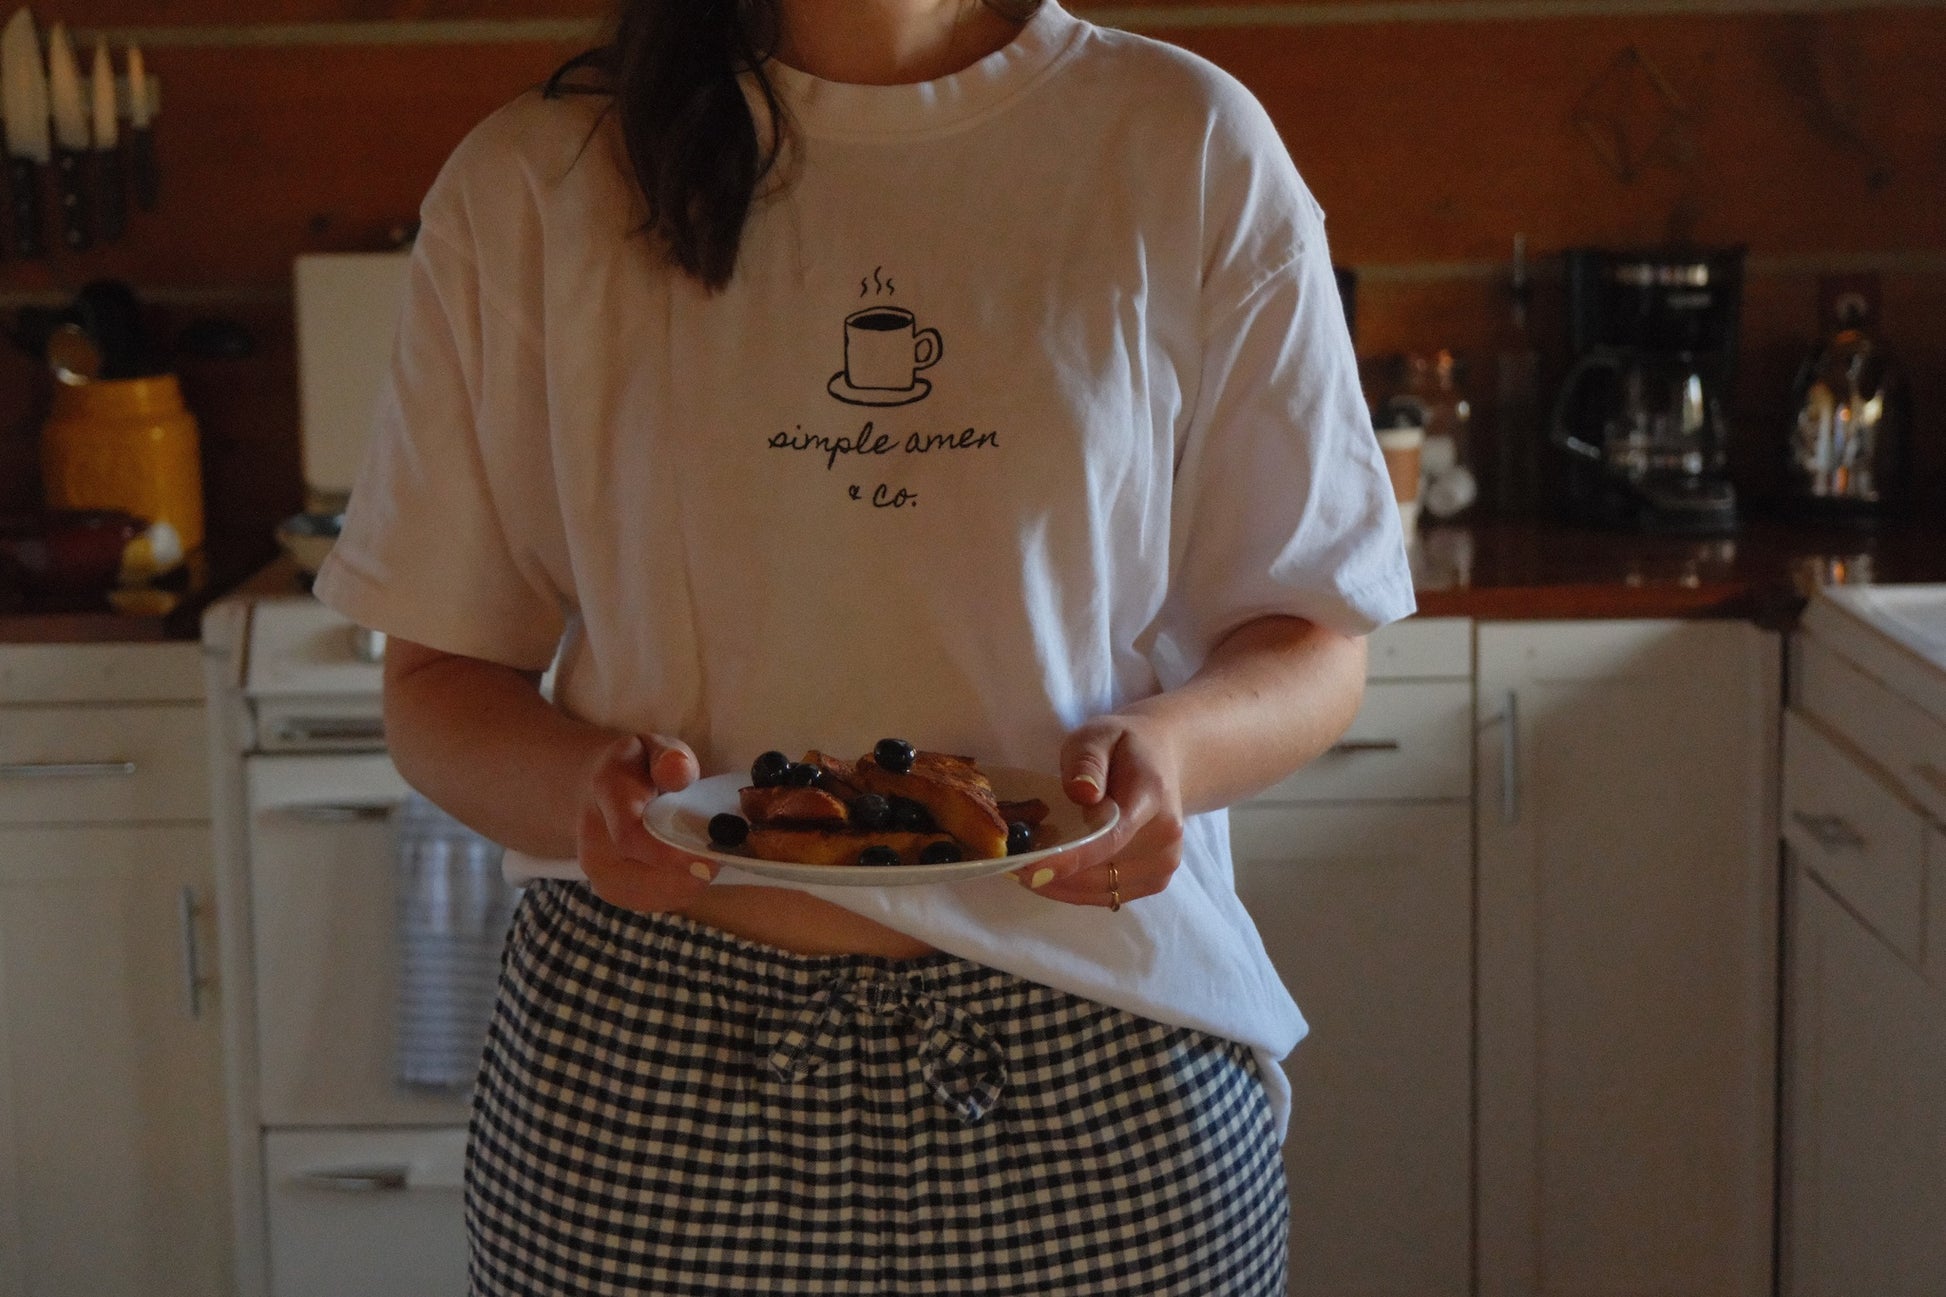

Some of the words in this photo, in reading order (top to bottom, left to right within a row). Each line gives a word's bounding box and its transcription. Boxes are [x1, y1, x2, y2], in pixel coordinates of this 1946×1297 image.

[768, 421, 900, 470] simple
[904, 428, 1000, 453] amen
[848, 484, 862, 500] &
